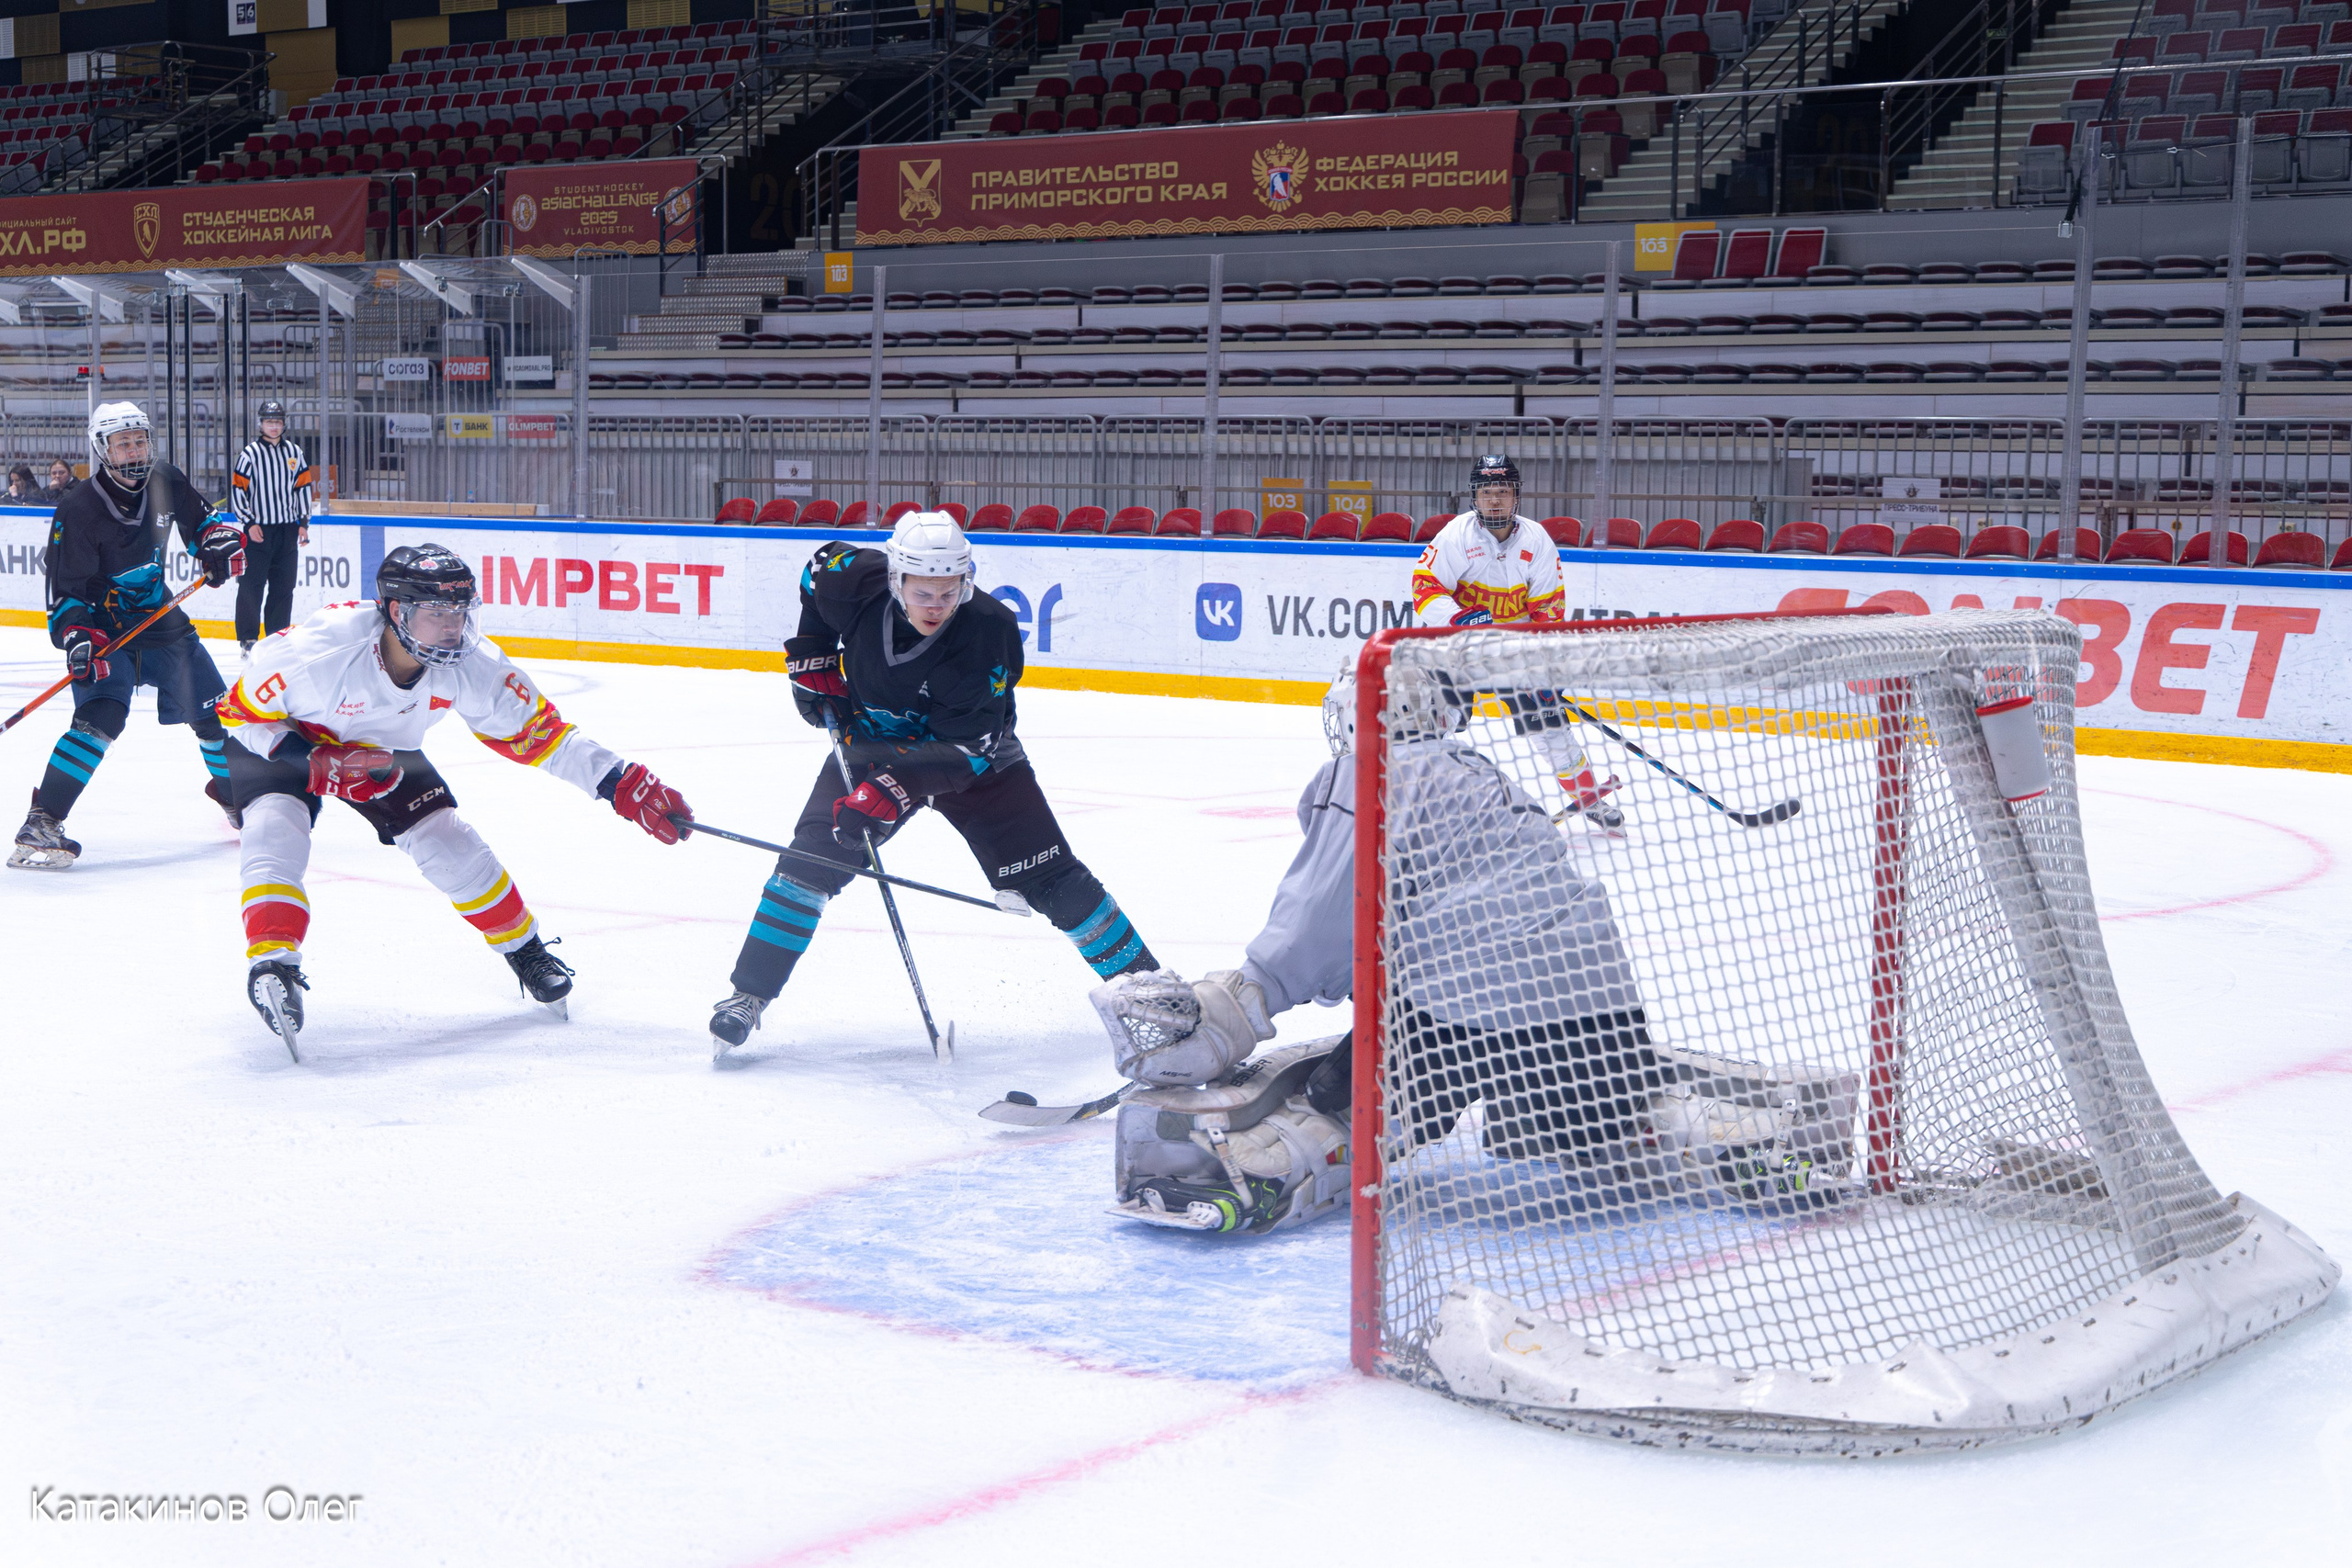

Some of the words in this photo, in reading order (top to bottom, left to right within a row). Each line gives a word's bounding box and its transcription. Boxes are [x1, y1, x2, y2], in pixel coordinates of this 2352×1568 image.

[1315, 151, 1459, 173] ФЕДЕРАЦИЯ
[972, 162, 1179, 188] ПРАВИТЕЛЬСТВО
[1314, 174, 1406, 192] ХОККЕЯ
[1411, 169, 1508, 187] РОССИИ
[554, 185, 600, 195] STUDENT
[604, 183, 644, 193] HOCKEY
[970, 186, 1153, 210] ПРИМОРСКОГО
[1159, 182, 1227, 201] КРАЯ
[0, 217, 53, 229] ИЦИАЛЬНЫЙ
[55, 216, 77, 226] САЙТ
[183, 207, 314, 227] СТУДЕНЧЕСКАЯ
[580, 210, 618, 226] 2025
[183, 225, 285, 245] ХОККЕЙНАЯ
[288, 225, 333, 241] ЛИГА
[563, 225, 635, 236] VLADIVOSTOK
[1641, 237, 1668, 253] 103
[831, 265, 847, 282] 103
[445, 362, 489, 376] FONBET
[465, 423, 488, 431] БАНК
[508, 423, 555, 432] OLIMPBET
[1268, 493, 1296, 509] 103
[1334, 496, 1366, 512] 104
[481, 555, 724, 616] IMPBET
[1469, 613, 1493, 626] BAU
[786, 654, 839, 674] AUER
[254, 672, 287, 705] 6
[504, 673, 531, 705] 6
[202, 689, 228, 709] CC
[326, 756, 342, 796] CM
[407, 785, 446, 812] CCM
[875, 773, 911, 816] BAU
[998, 844, 1061, 878] BAUER
[1233, 1058, 1272, 1088] BAUER
